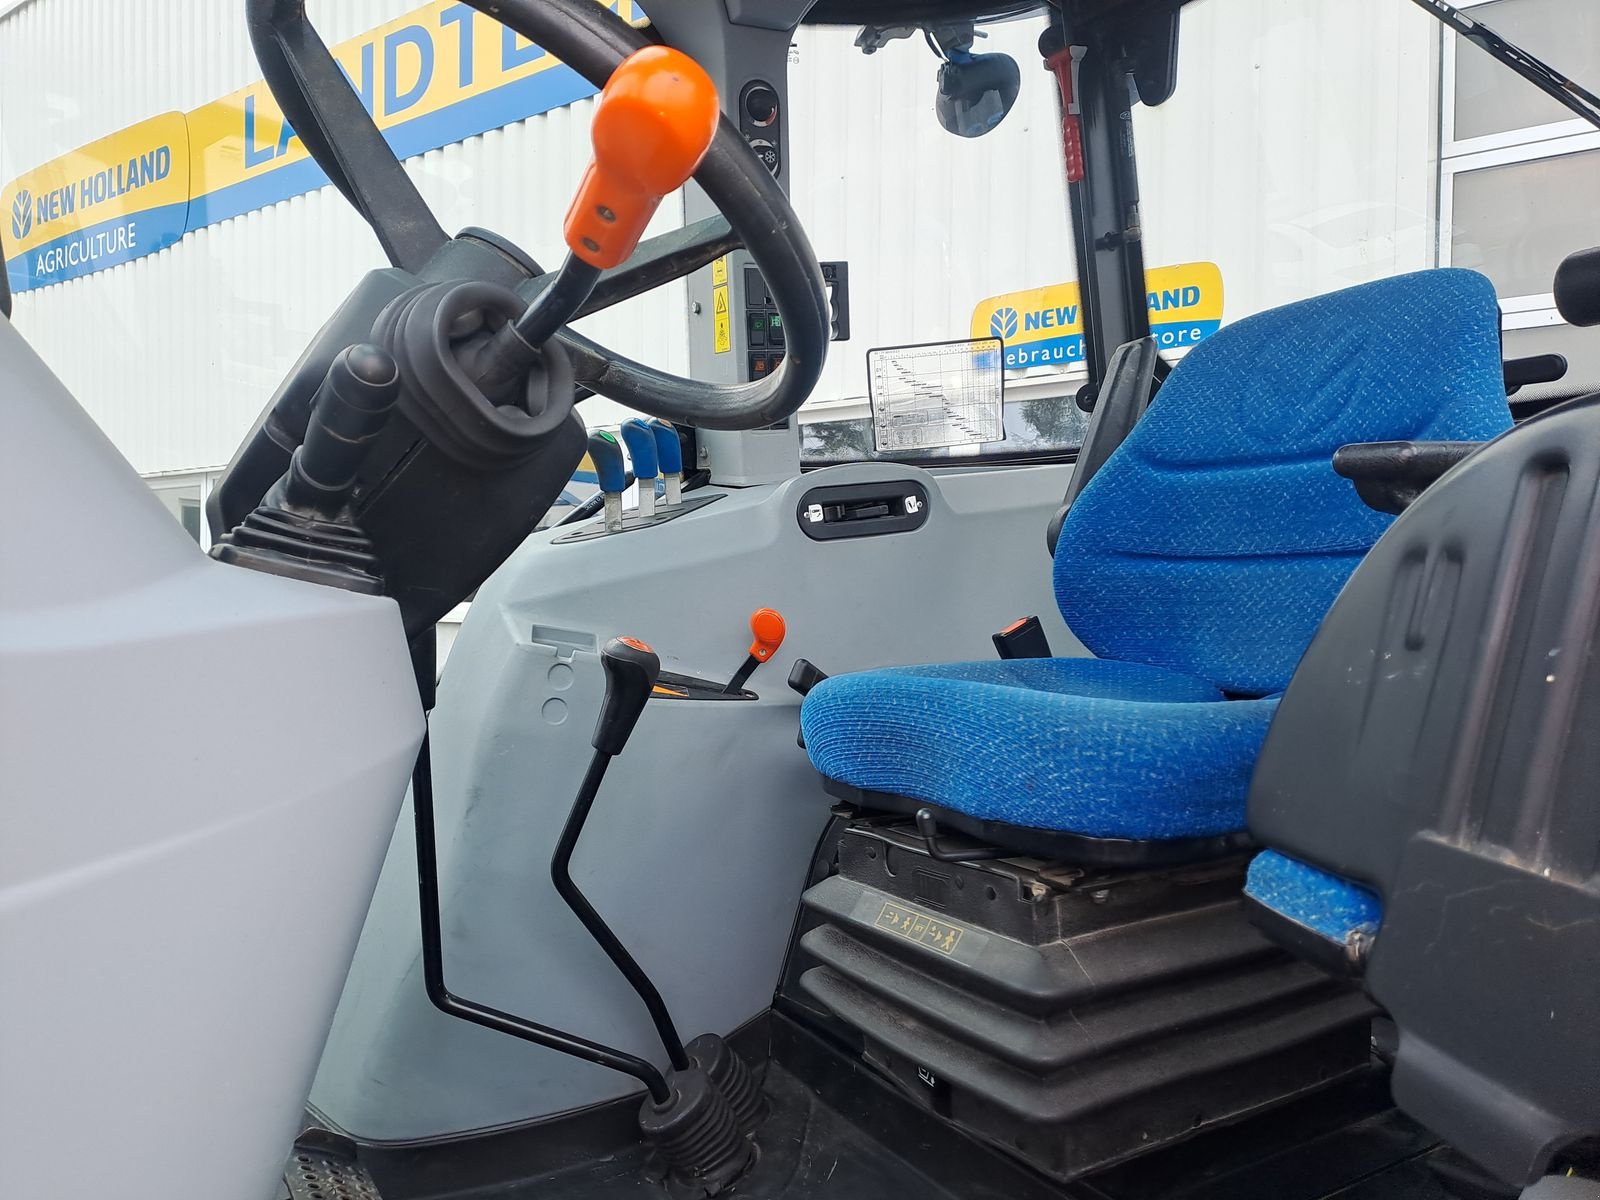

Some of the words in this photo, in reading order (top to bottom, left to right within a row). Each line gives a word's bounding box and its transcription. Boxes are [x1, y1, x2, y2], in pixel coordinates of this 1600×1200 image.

[36, 183, 76, 225] NEW
[80, 145, 171, 209] HOLLAND
[35, 222, 137, 277] AGRICULTURE
[1024, 304, 1078, 331] NEW
